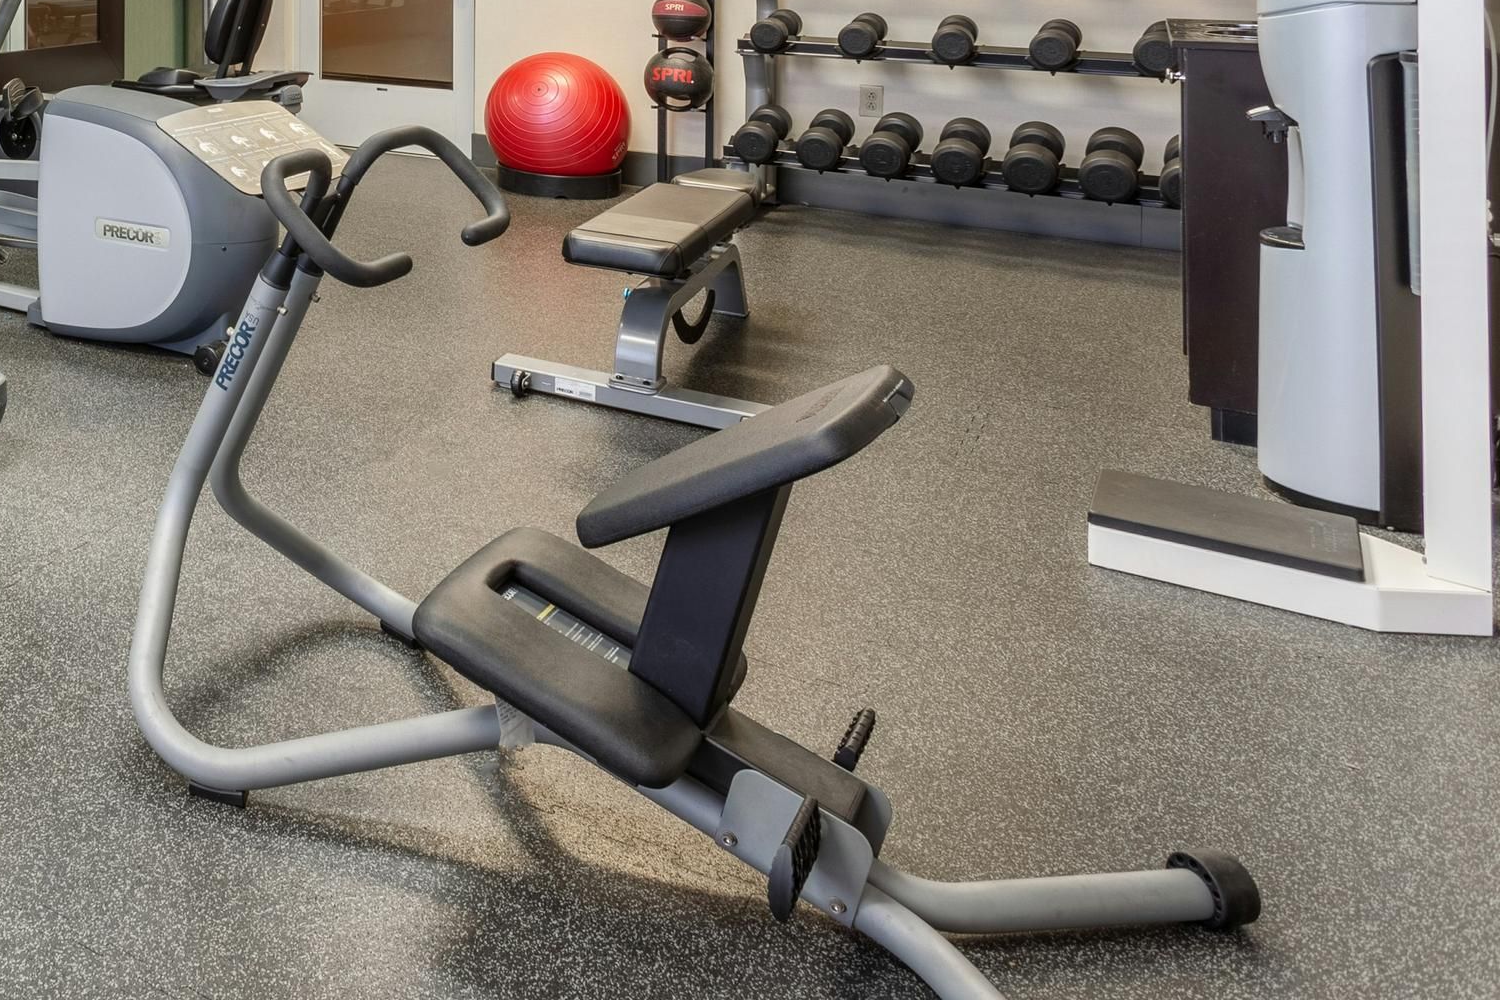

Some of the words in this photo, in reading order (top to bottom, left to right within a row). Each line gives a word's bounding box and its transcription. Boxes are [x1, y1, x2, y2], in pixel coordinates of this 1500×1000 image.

[665, 3, 684, 12] SPRI
[103, 224, 154, 244] PRECOR
[215, 321, 256, 391] PRECOR
